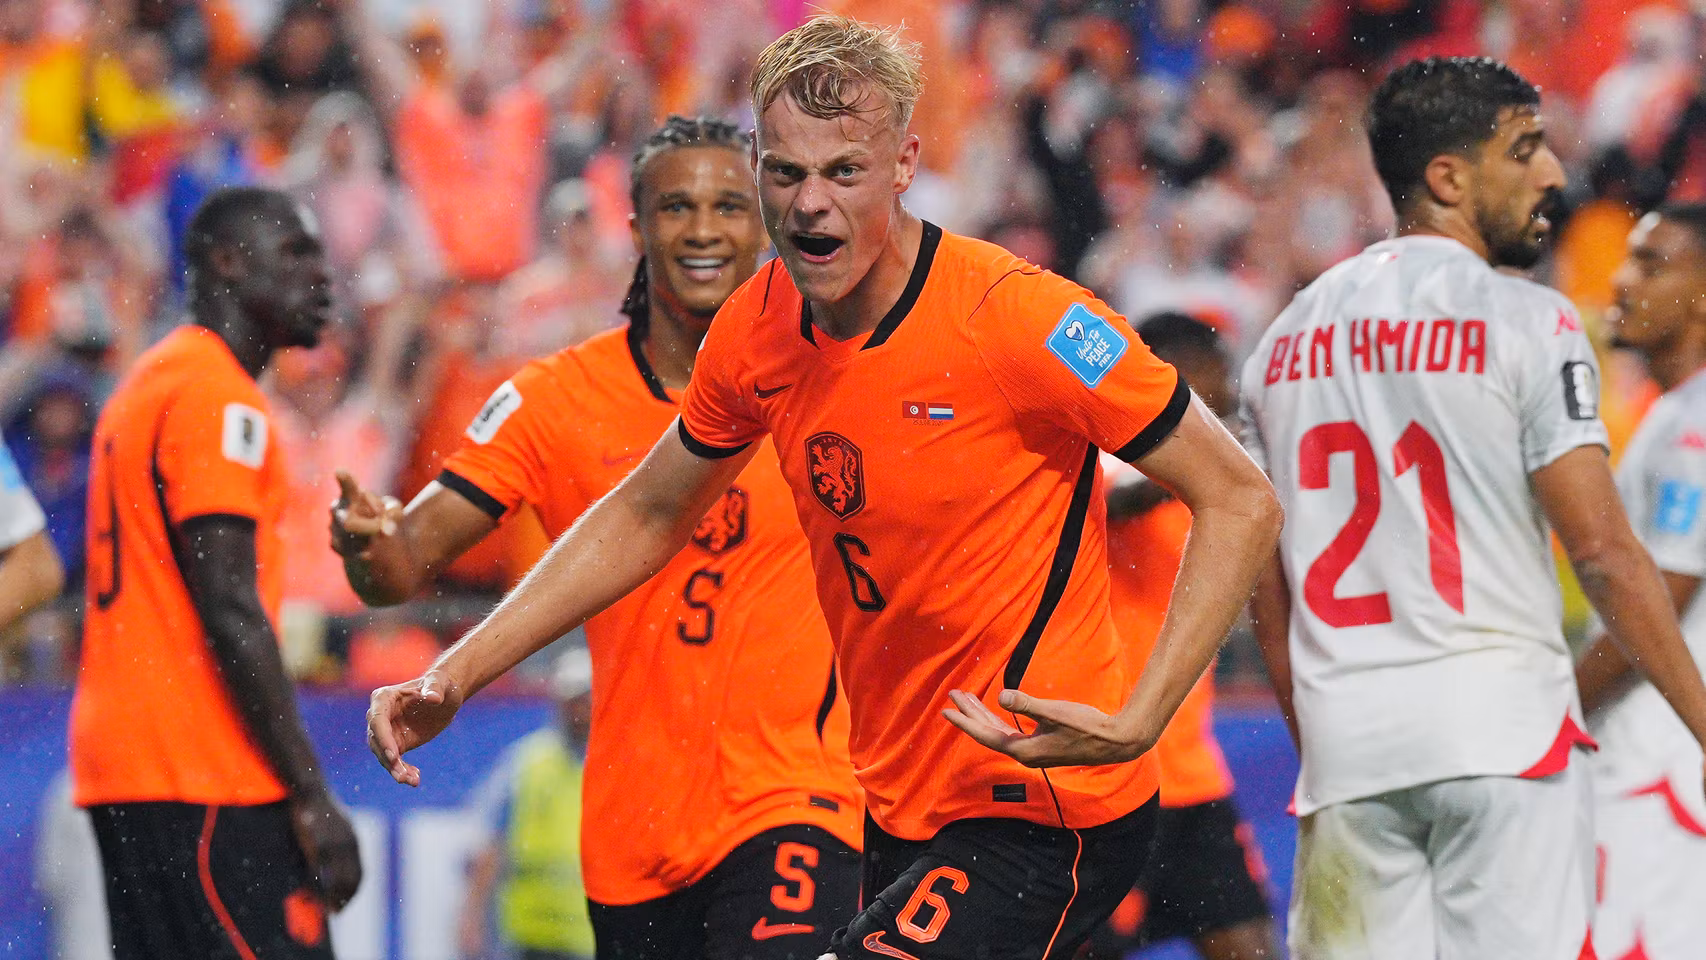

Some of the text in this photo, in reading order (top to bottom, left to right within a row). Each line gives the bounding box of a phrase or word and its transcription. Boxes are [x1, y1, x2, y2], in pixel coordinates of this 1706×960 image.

[1085, 338, 1111, 367] PEACE
[1098, 353, 1113, 368] FIFA
[1264, 319, 1487, 387] BEN HMIDA
[1298, 419, 1465, 629] 21
[677, 568, 725, 647] 5
[833, 532, 887, 613] 6
[769, 841, 819, 913] 5
[895, 865, 970, 944] 6
